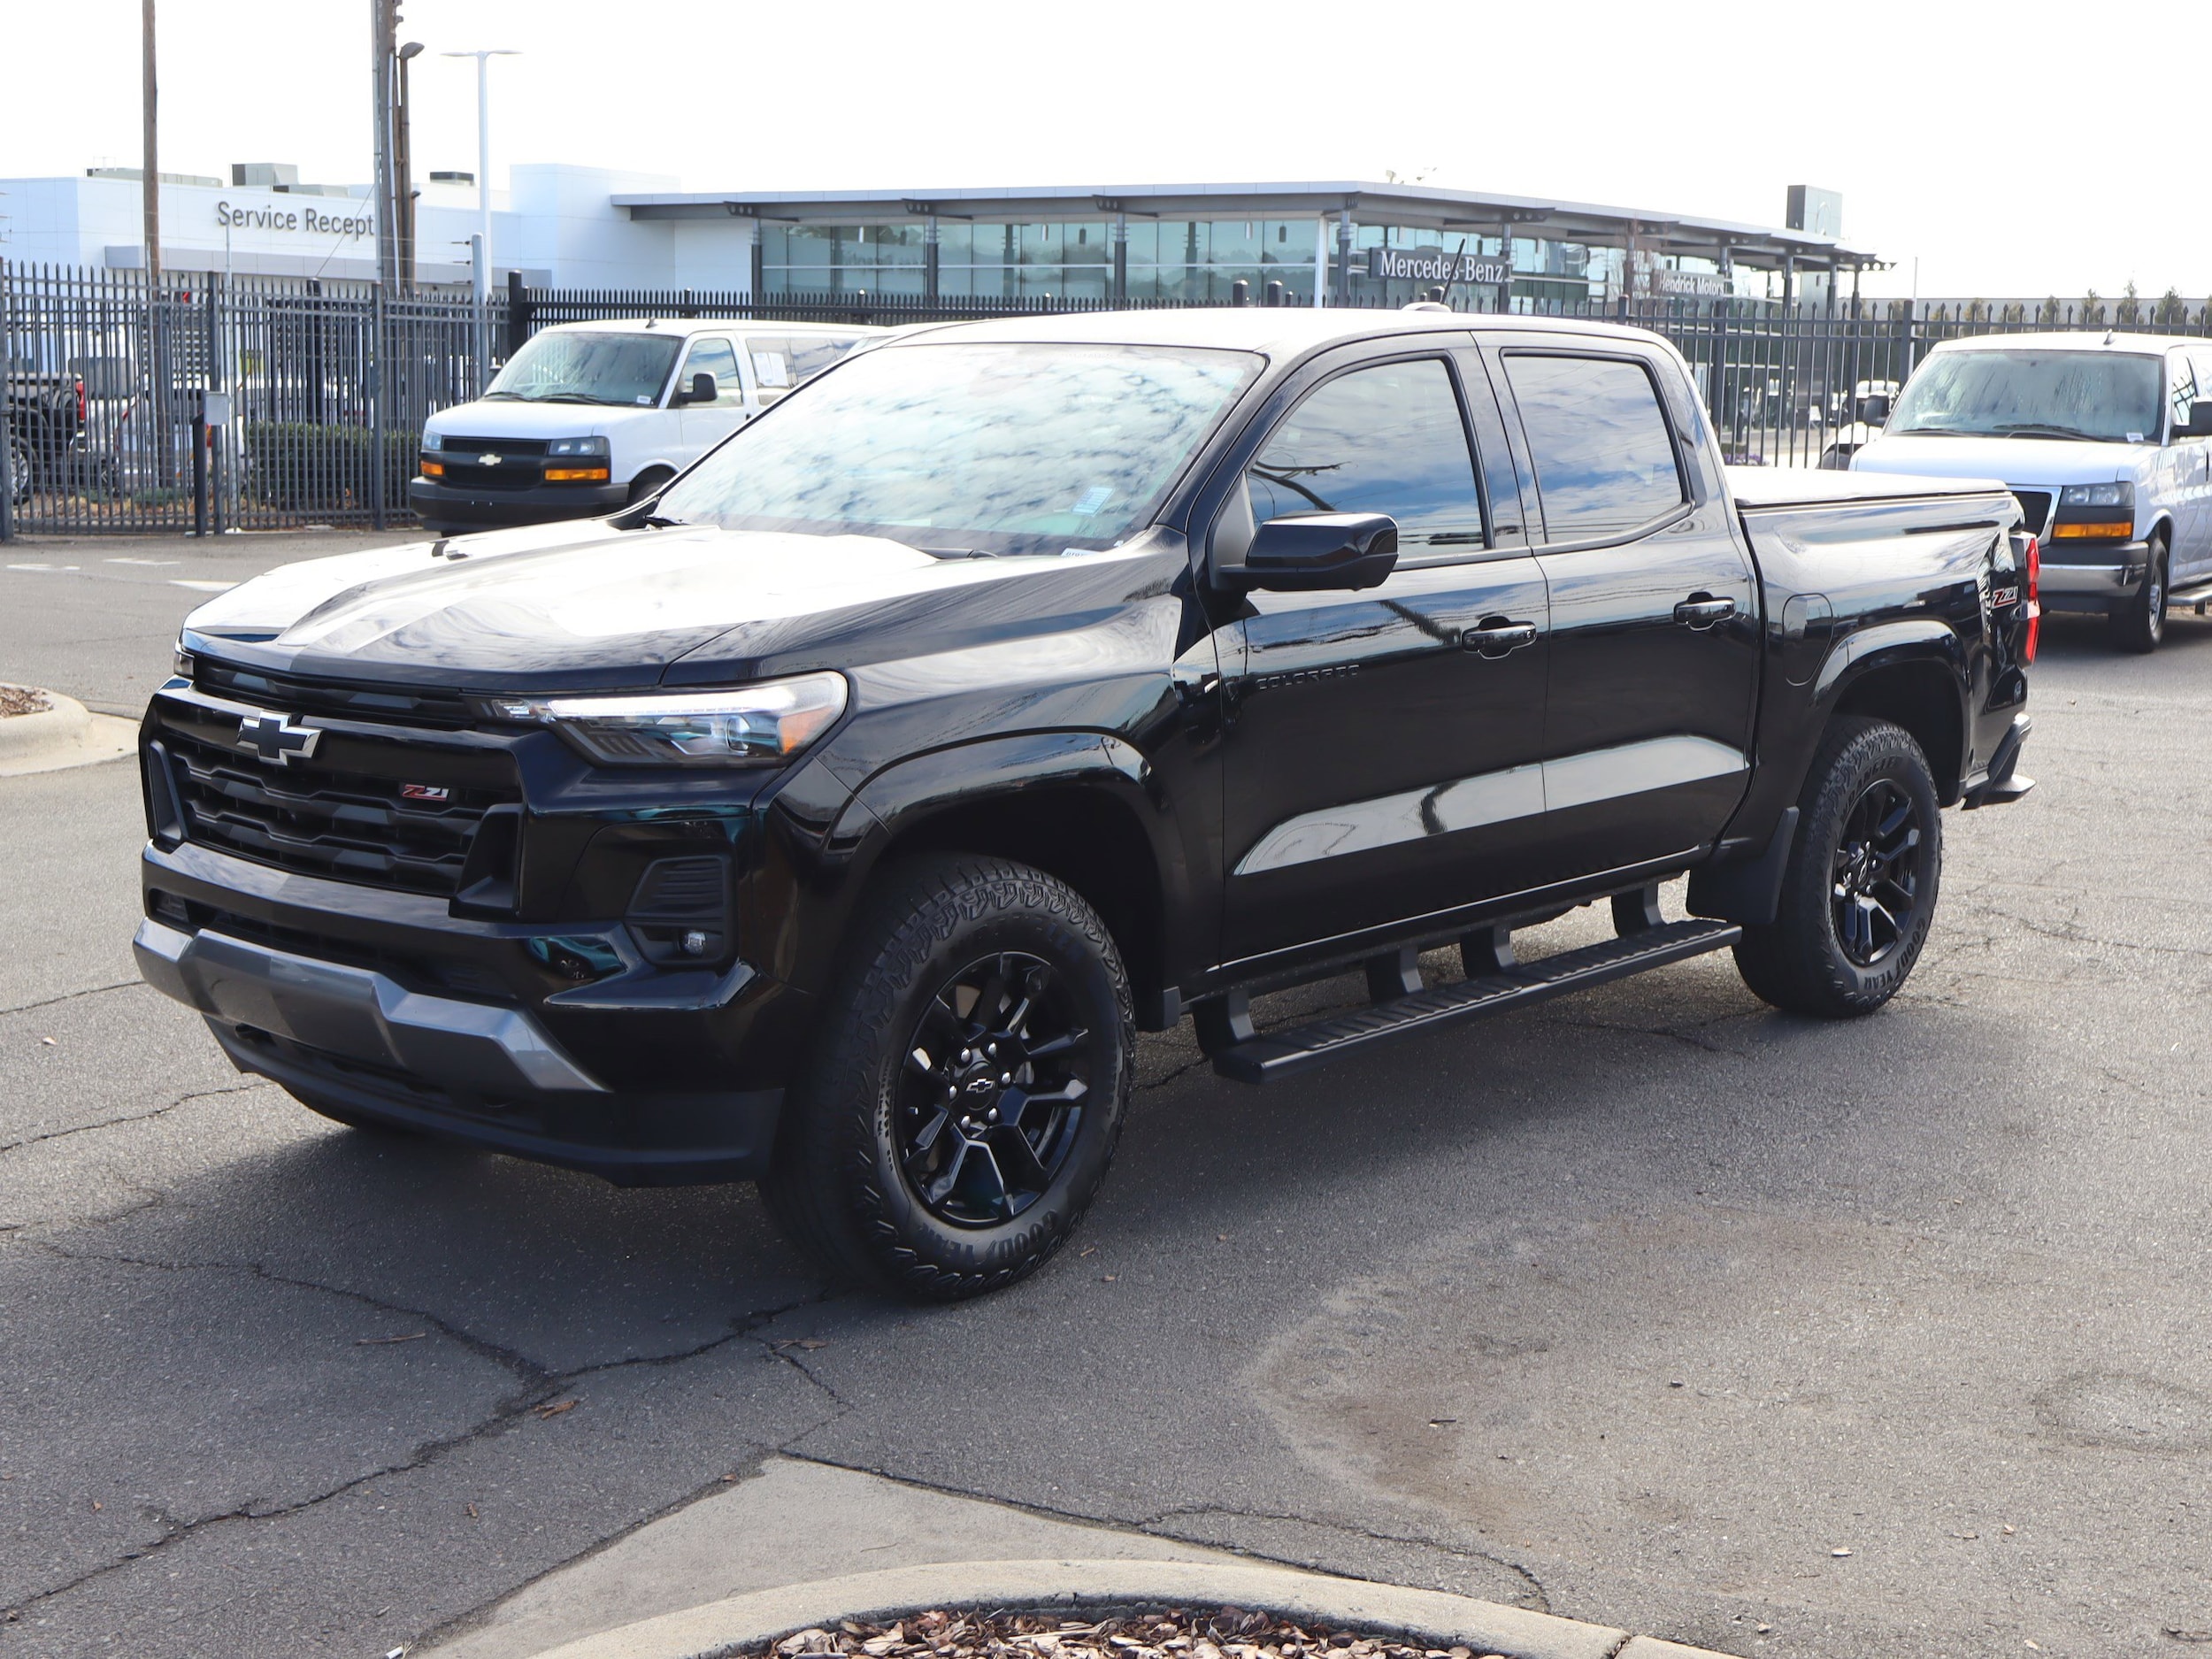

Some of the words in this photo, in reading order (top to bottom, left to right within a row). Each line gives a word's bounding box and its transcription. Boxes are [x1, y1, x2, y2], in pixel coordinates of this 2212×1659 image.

[217, 201, 297, 231] Service
[1379, 250, 1503, 284] Mercedes-Benz
[1659, 273, 1695, 295] Hendrick
[1696, 277, 1724, 296] Motors
[1991, 585, 2019, 610] Z71
[402, 784, 449, 802] Z71
